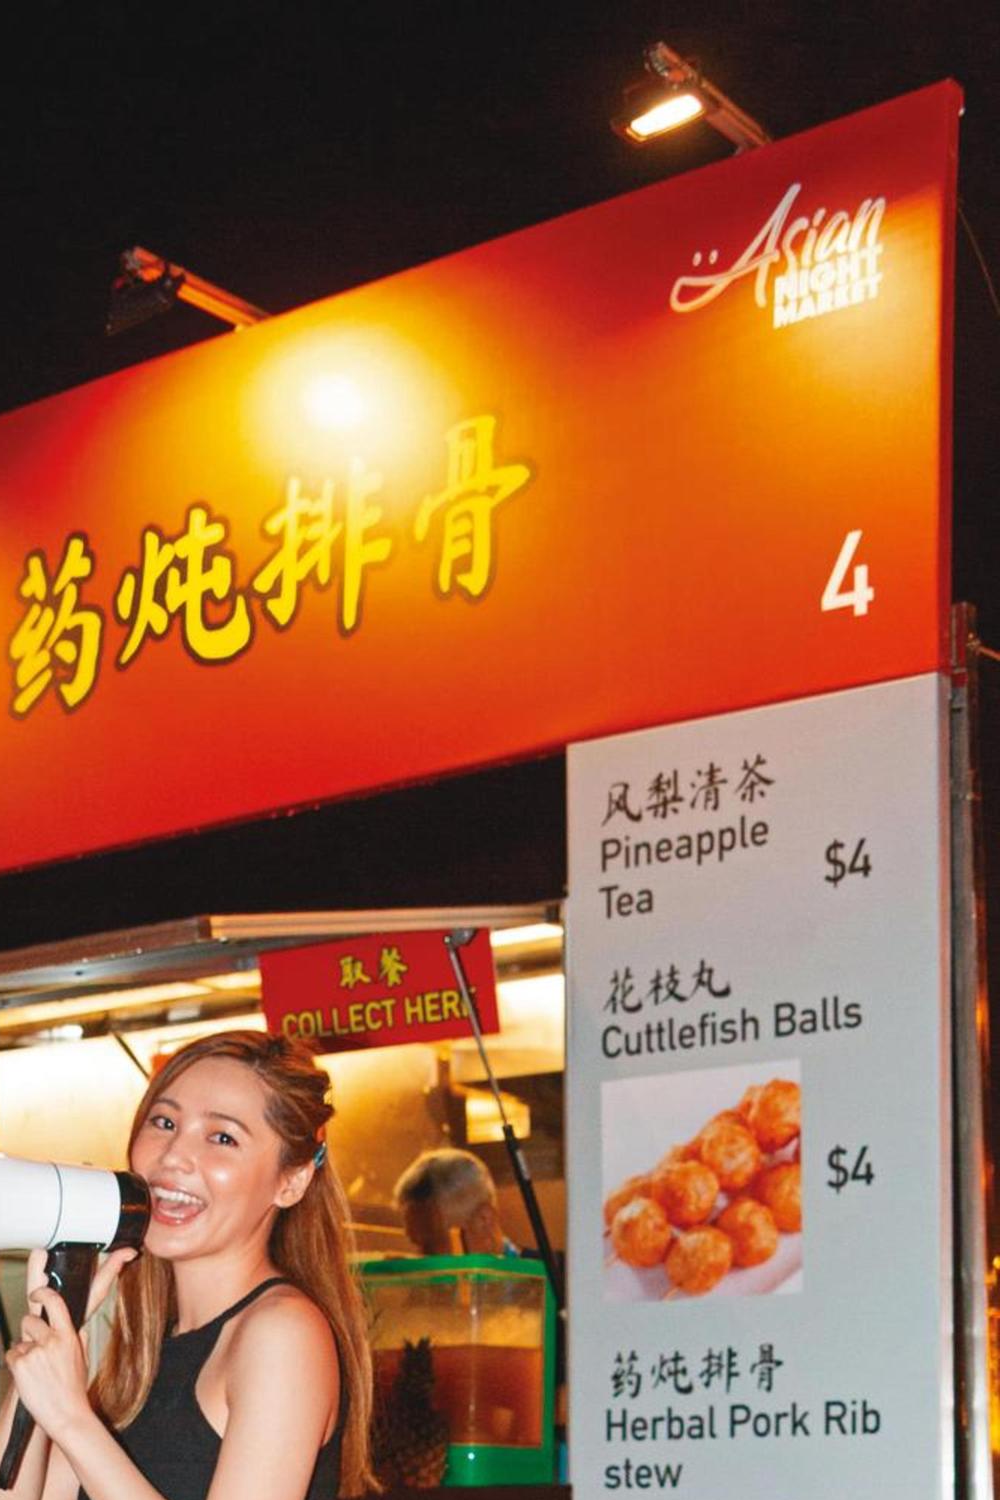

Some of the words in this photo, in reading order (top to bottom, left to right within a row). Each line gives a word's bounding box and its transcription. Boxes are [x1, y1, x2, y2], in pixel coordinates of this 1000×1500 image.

[670, 183, 885, 313] Asian
[774, 243, 883, 299] NIGHT
[773, 271, 883, 329] MARKET
[820, 529, 875, 617] 4
[601, 815, 769, 873] Pineapple
[824, 838, 873, 886] $4
[599, 885, 654, 919] Tea
[282, 1000, 396, 1038] COLLECT
[404, 987, 476, 1025] HER
[603, 959, 731, 1015] 花枝丸
[601, 1008, 760, 1059] Cuttlefish
[773, 995, 863, 1038] Balls
[826, 1145, 875, 1193] $4
[611, 1343, 783, 1398] 药炖排骨
[606, 1405, 716, 1442] Herbal
[729, 1402, 811, 1438] Pork
[824, 1399, 881, 1436] Rib
[604, 1458, 683, 1489] stew
